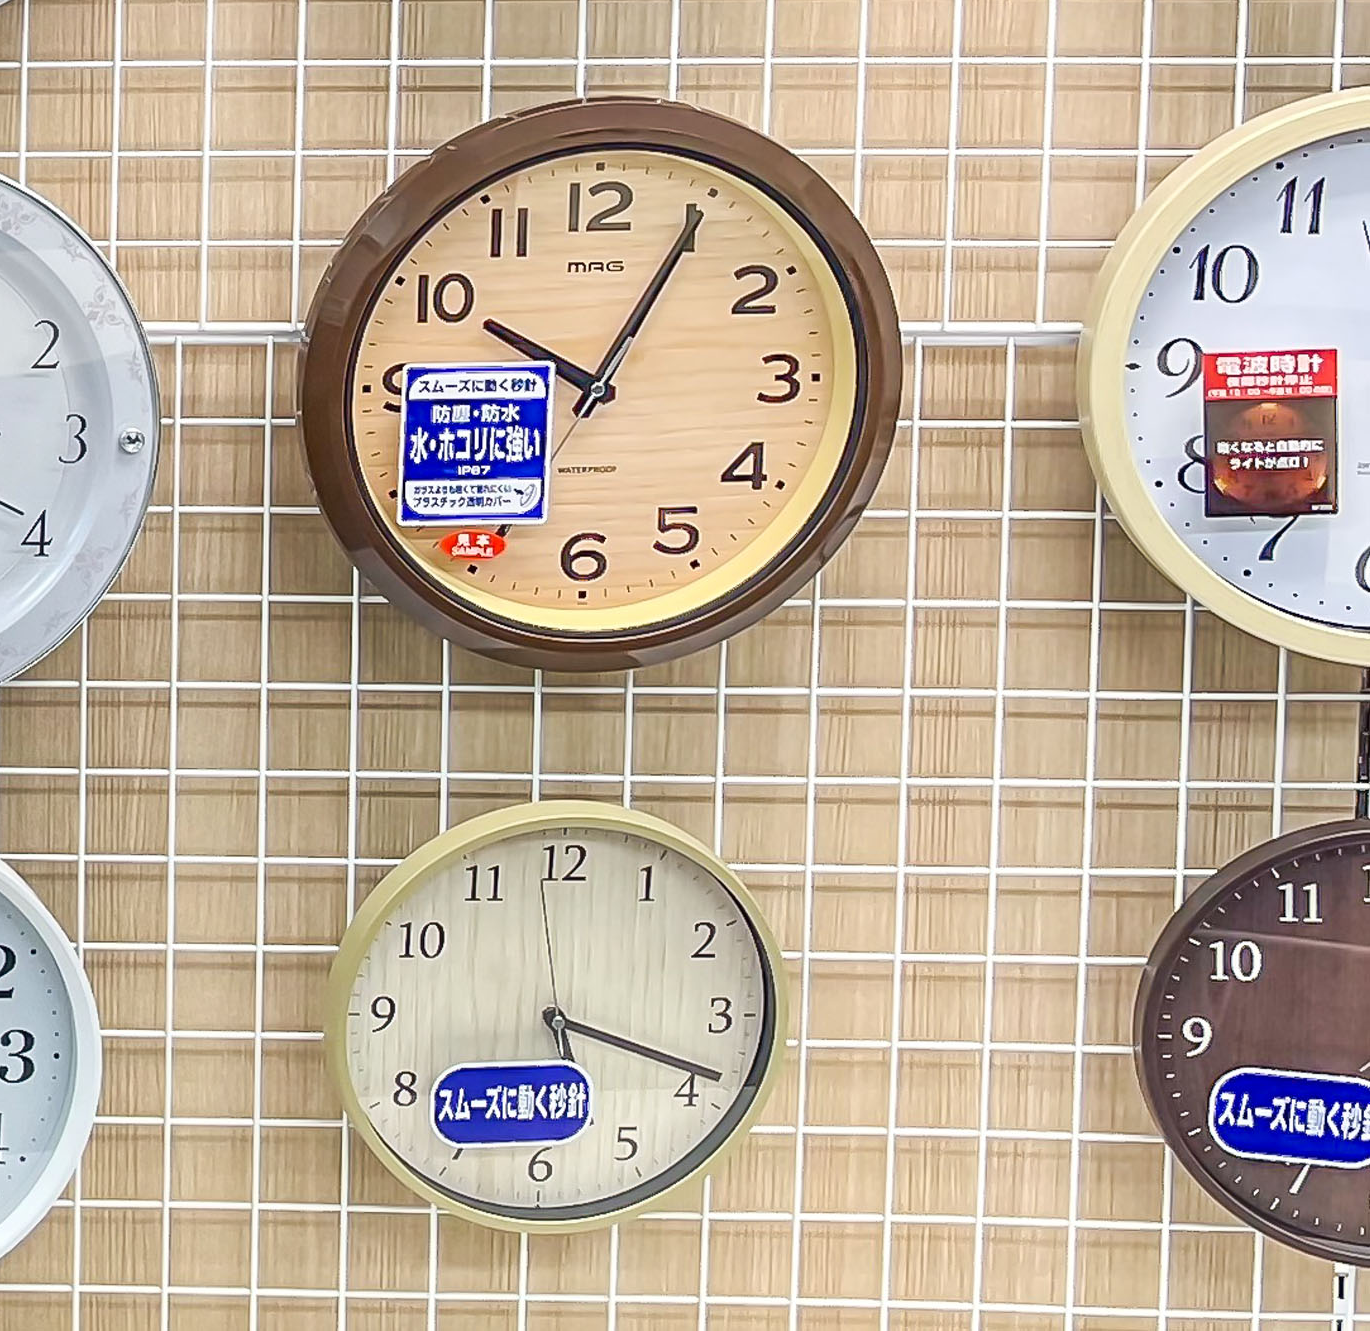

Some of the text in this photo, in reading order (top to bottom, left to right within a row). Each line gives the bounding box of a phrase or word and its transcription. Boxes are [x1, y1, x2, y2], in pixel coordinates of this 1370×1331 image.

[569, 182, 633, 232] 12
[1277, 177, 1325, 234] 11
[567, 260, 625, 272] MAG
[1189, 245, 1258, 303] 10
[418, 274, 473, 323] 10
[31, 320, 59, 368] 2
[1216, 353, 1324, 375] 電波時計
[419, 379, 537, 393] スムーズに動く秒針
[1157, 338, 1201, 398] 9
[410, 426, 540, 463] 水・ホコリに強い
[721, 442, 767, 490] 4
[21, 510, 52, 556] 4
[452, 547, 494, 556] SAMPLE
[561, 533, 606, 581] 6
[465, 865, 503, 901] 11
[541, 845, 586, 886] 12
[1278, 884, 1322, 922] 11
[399, 922, 444, 958] 10
[1210, 941, 1261, 981] 10
[1183, 1018, 1212, 1056] 9
[438, 1082, 588, 1123] スムーズに動く秒針
[529, 1147, 552, 1182] 6
